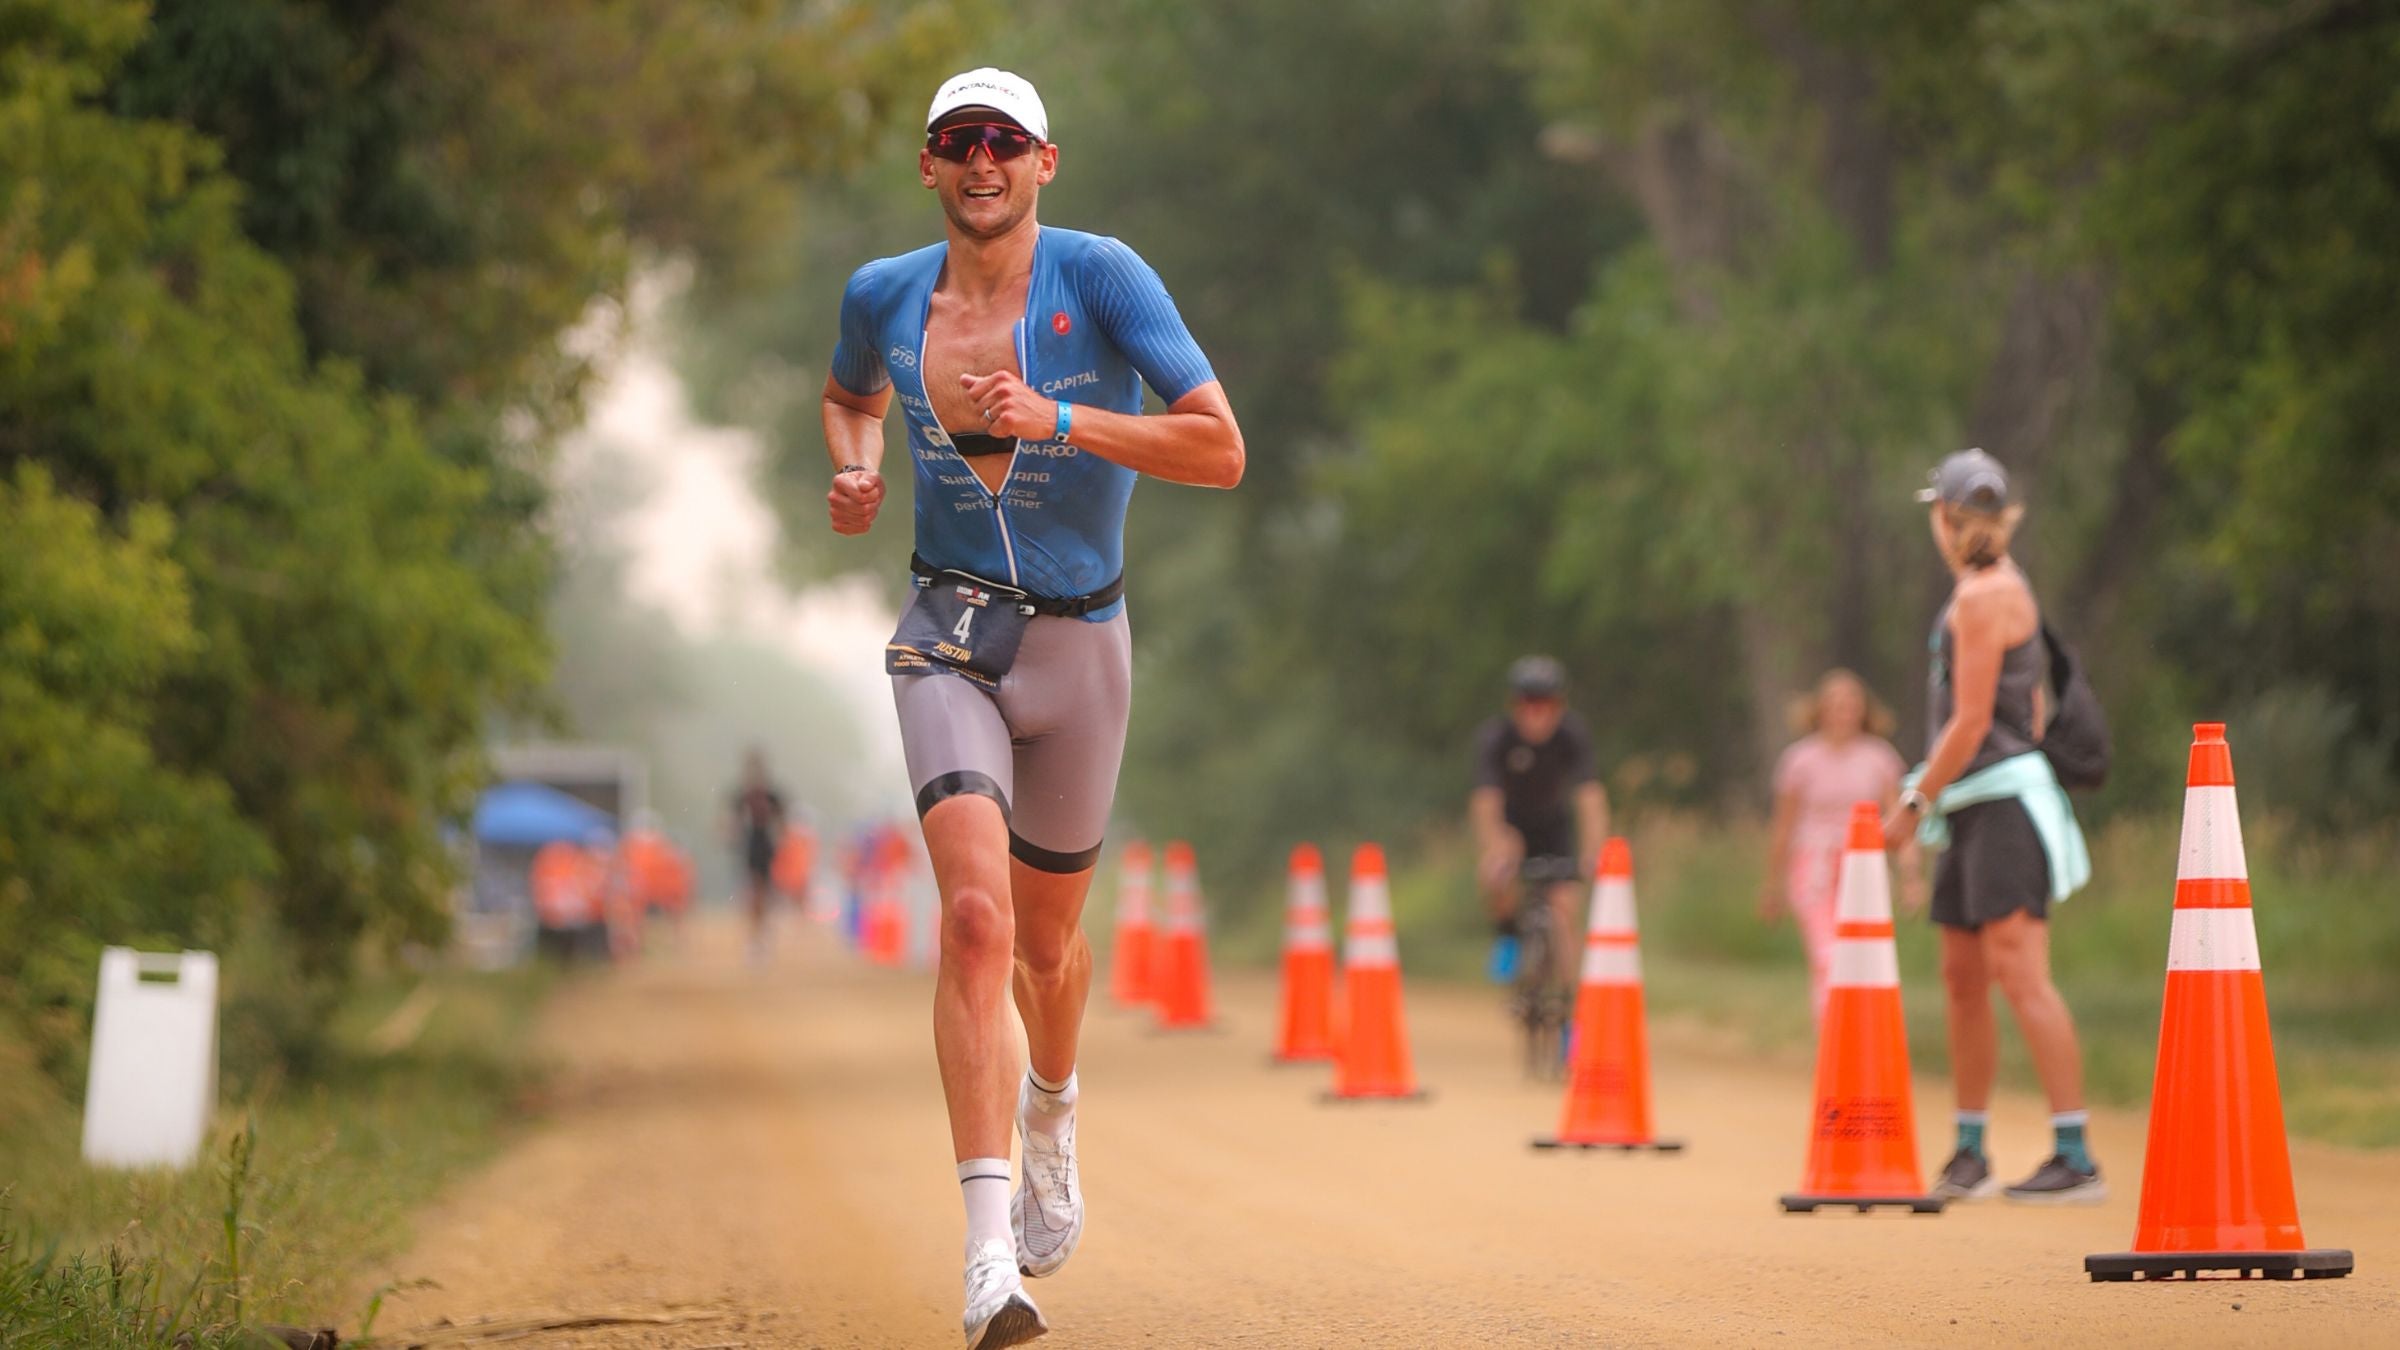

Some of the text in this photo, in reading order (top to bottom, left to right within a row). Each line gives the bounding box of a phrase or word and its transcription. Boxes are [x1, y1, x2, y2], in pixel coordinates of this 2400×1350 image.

[889, 347, 916, 367] PTO
[1042, 370, 1100, 393] CAPITAL
[1042, 445, 1078, 458] ROO
[952, 606, 975, 644] 4
[933, 642, 972, 663] JUSTIN
